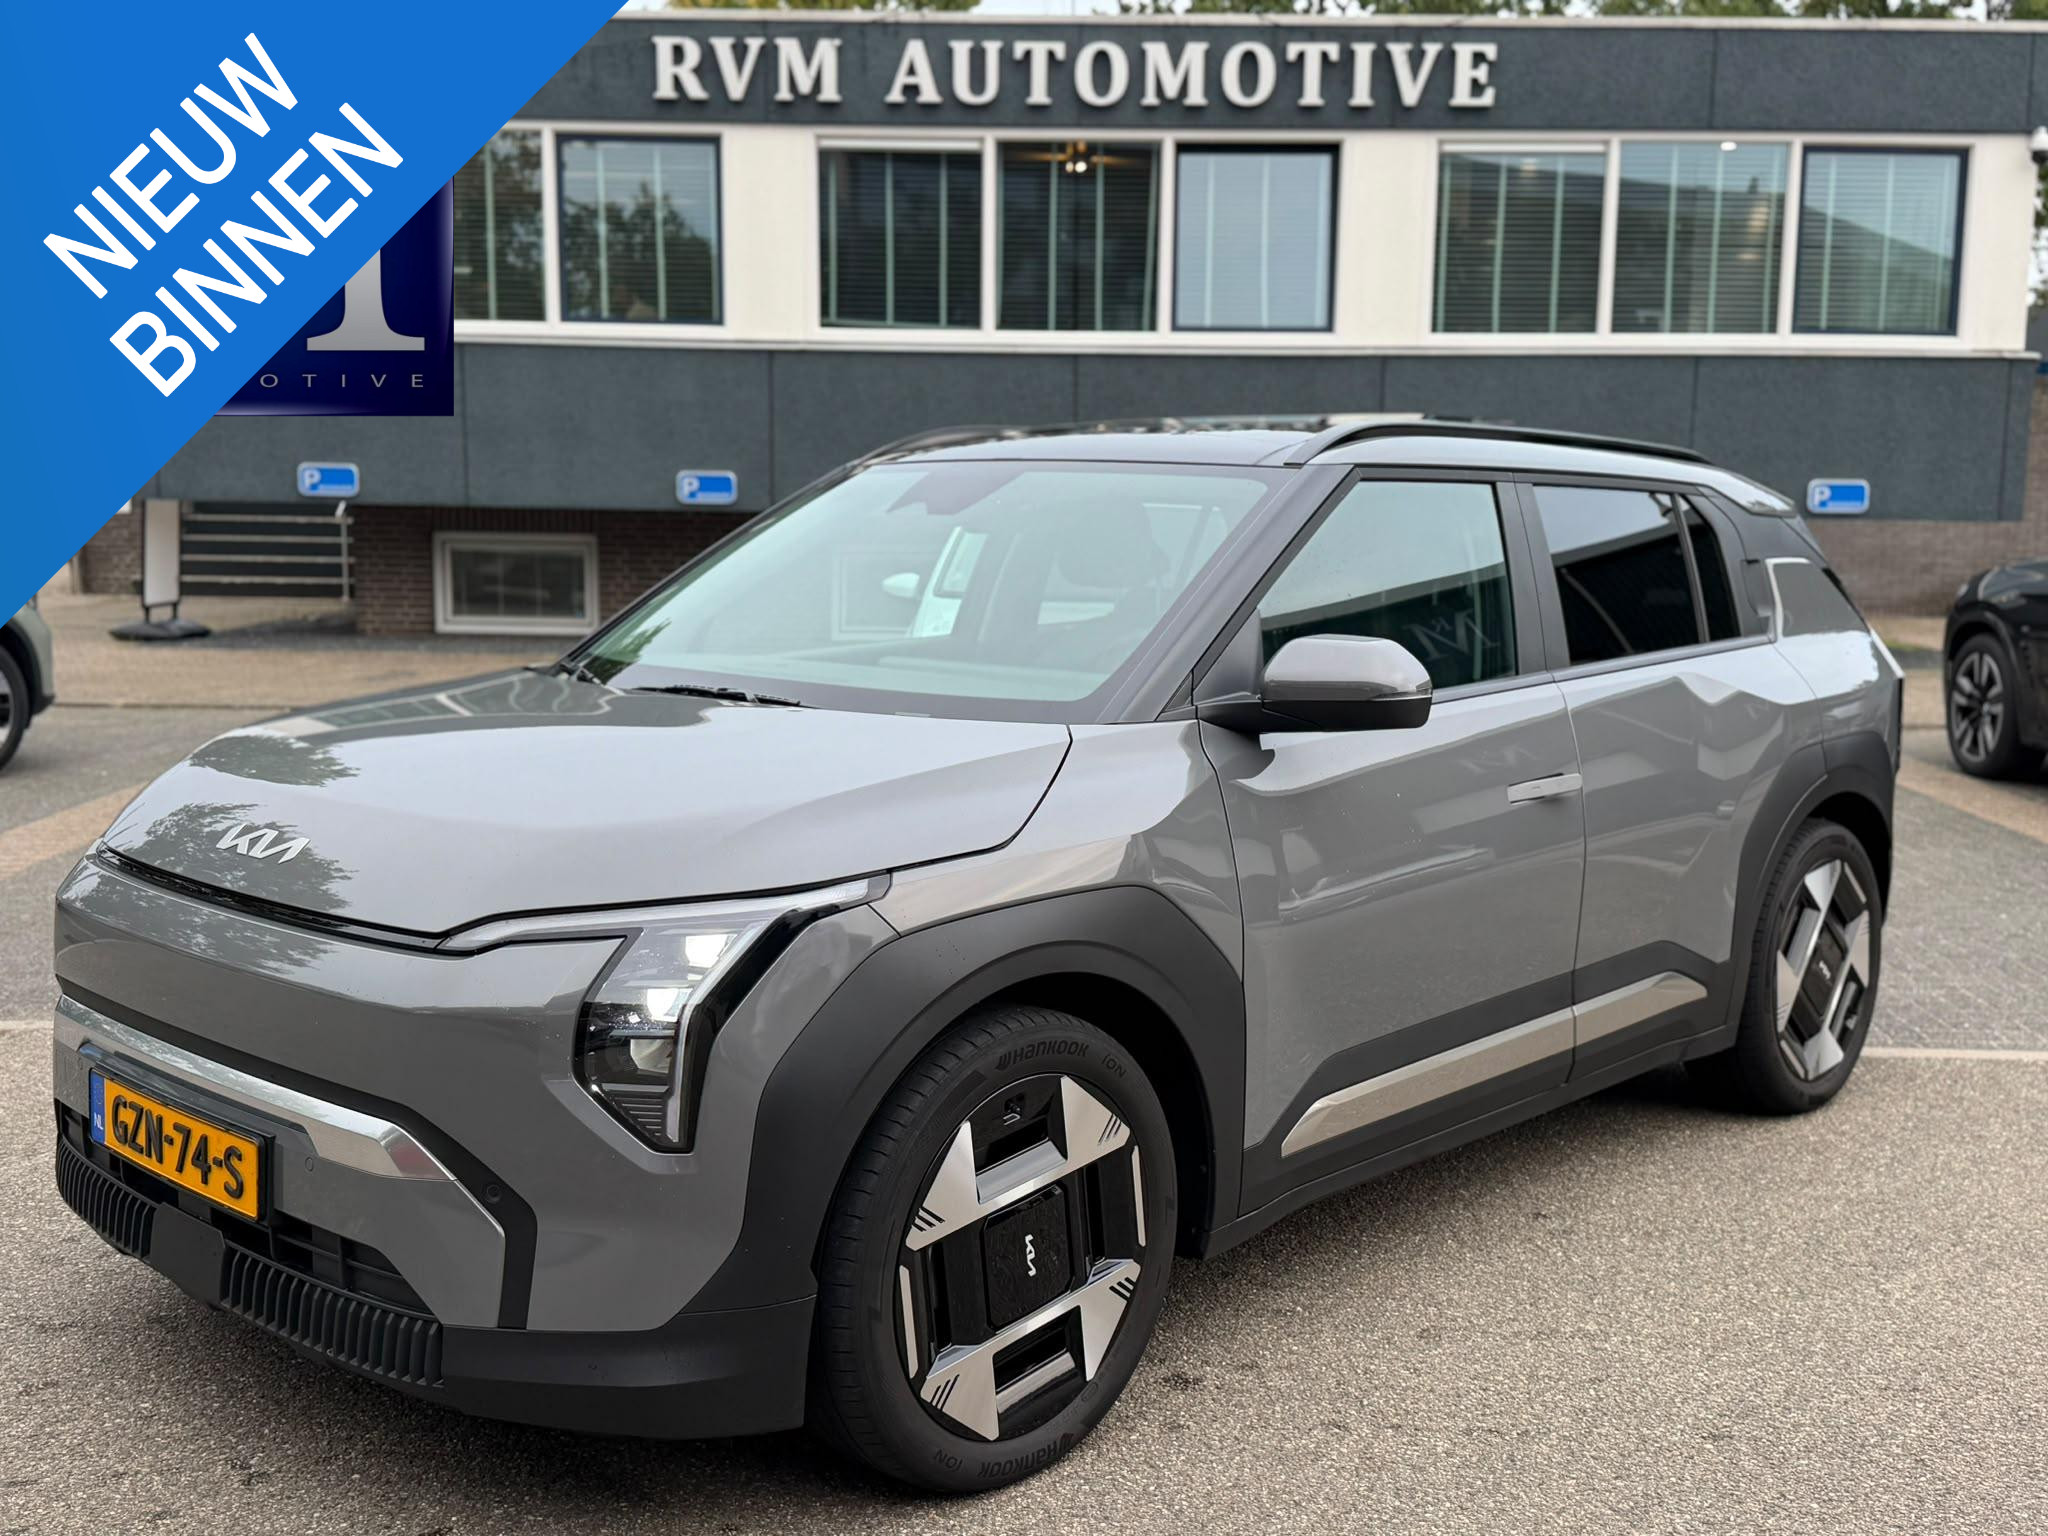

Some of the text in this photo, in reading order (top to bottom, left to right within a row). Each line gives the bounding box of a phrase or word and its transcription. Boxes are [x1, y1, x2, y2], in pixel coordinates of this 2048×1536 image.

[651, 35, 1497, 107] RVM AUTOMOTIVE
[111, 1094, 245, 1200] GZN-74-S
